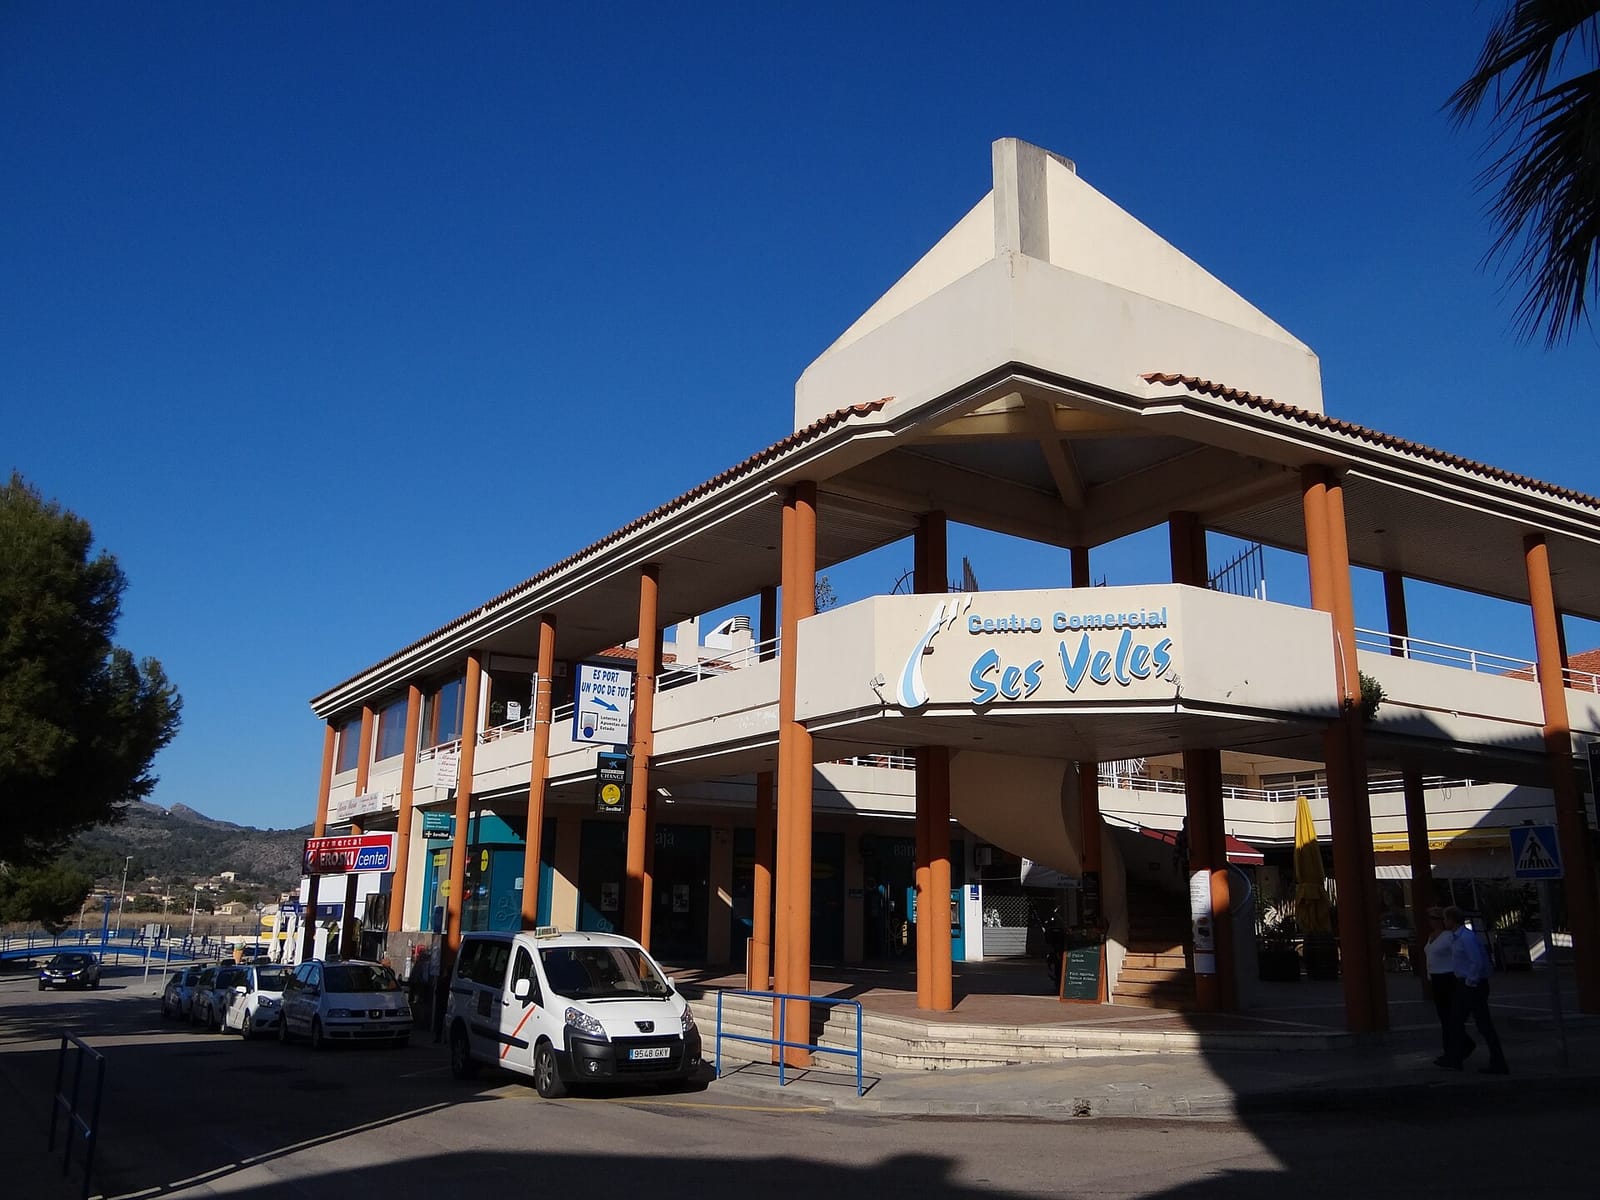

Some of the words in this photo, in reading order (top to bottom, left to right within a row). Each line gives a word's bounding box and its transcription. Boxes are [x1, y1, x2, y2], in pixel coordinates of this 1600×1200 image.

[968, 614, 1042, 634] Centro
[1052, 607, 1167, 632] Comercial
[592, 669, 602, 680] ES
[602, 671, 619, 683] PORT
[969, 649, 1044, 705] Ses
[1059, 630, 1173, 693] Veles
[581, 681, 592, 693] UN
[592, 683, 606, 695] POC
[606, 685, 617, 696] DE
[617, 687, 629, 698] TOT
[307, 837, 362, 849] Supermercat
[320, 850, 354, 867] EROSKI
[358, 852, 388, 866] center
[634, 1049, 653, 1058] 9548
